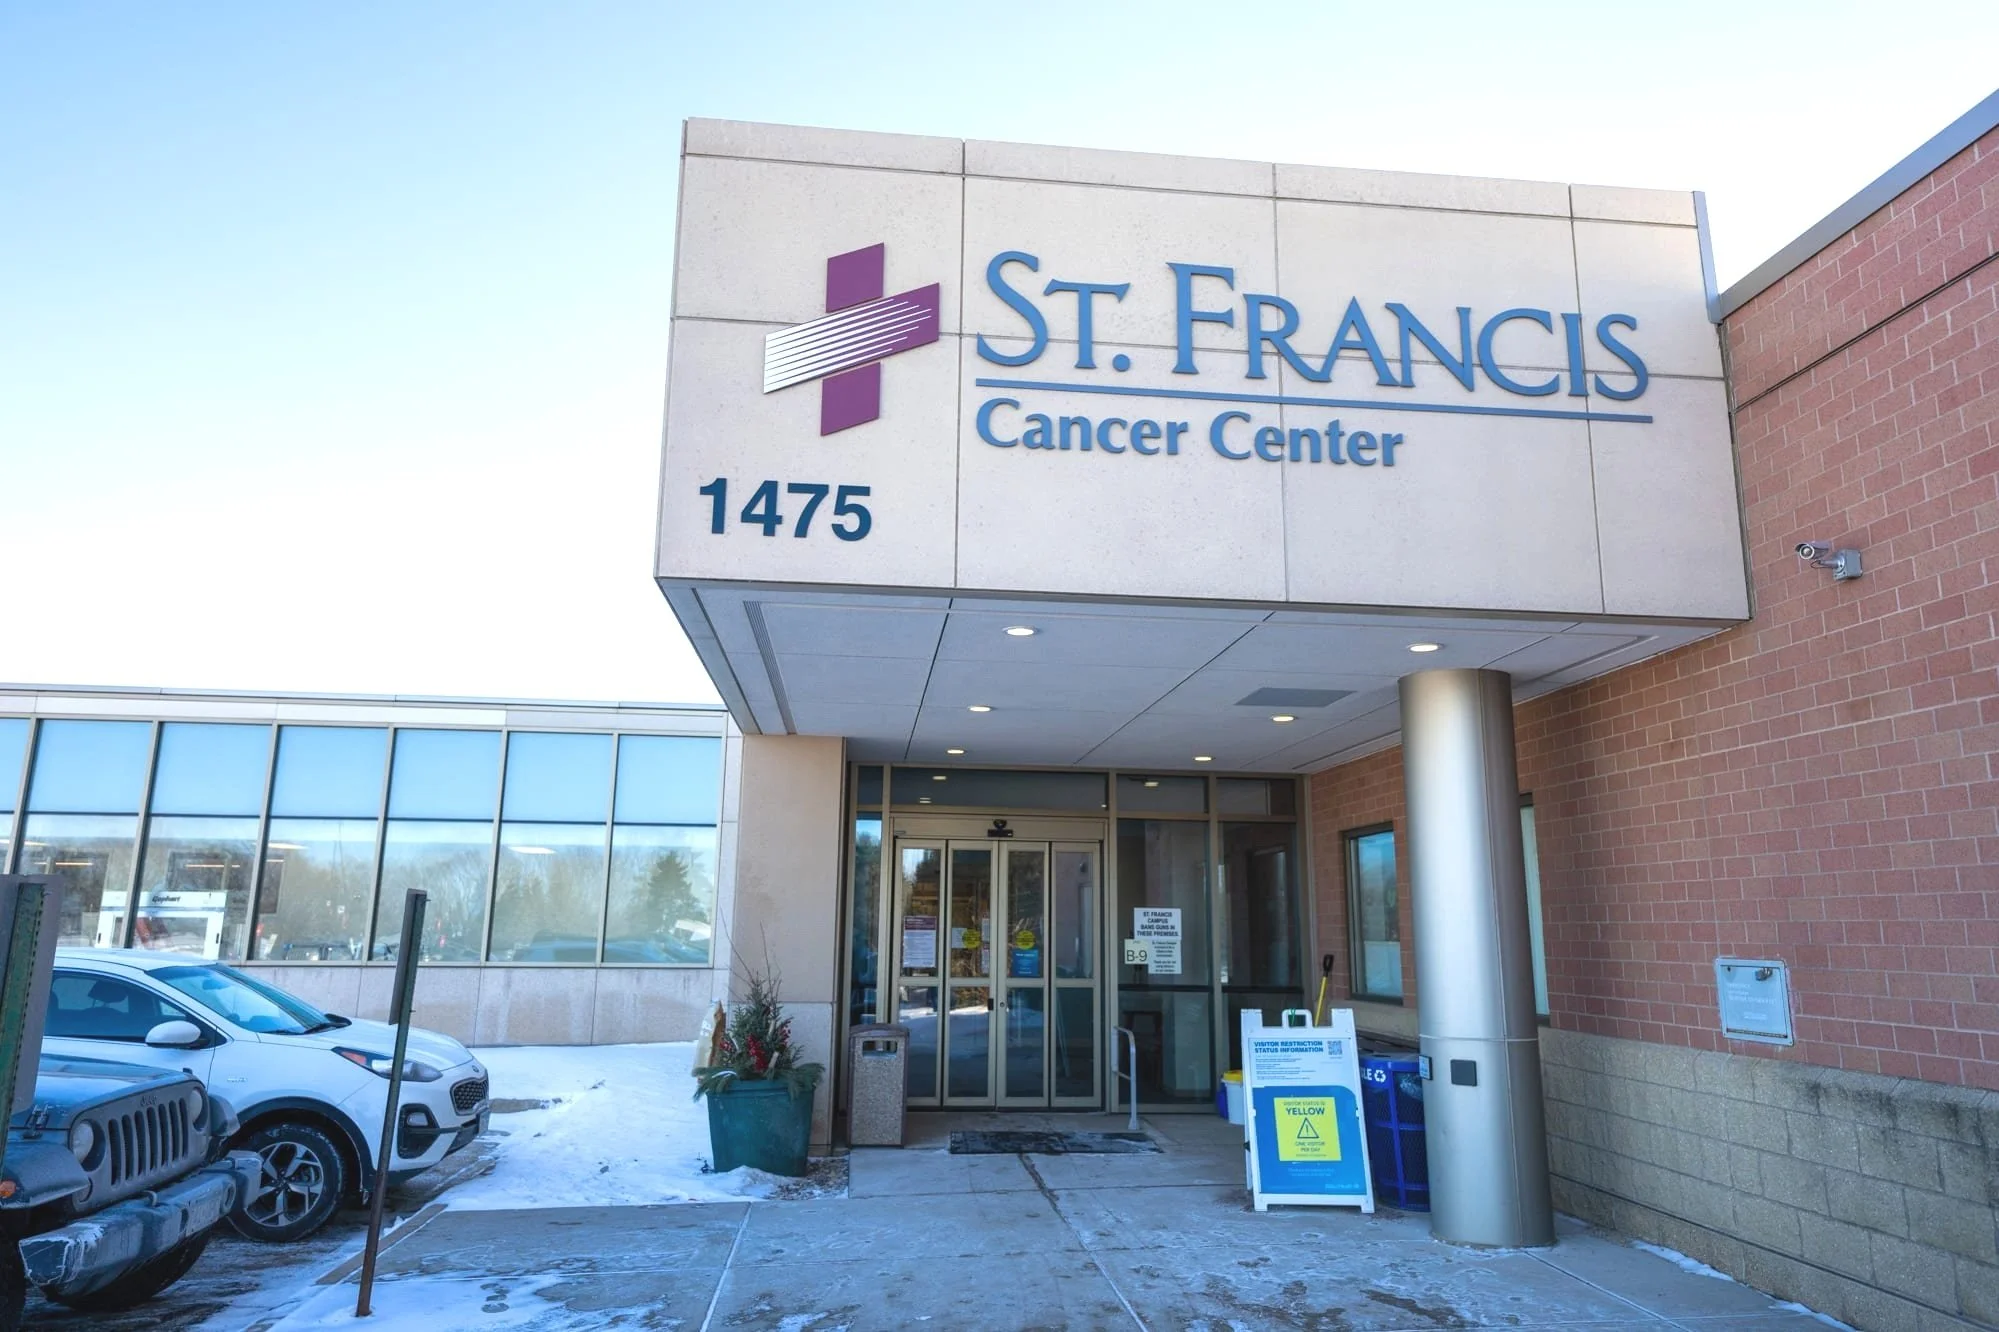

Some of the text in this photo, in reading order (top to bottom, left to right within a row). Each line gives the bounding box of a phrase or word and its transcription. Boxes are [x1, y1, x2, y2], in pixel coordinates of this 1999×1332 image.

[977, 250, 1649, 401] ST. FRANCIS
[976, 397, 1404, 467] Cancer Center
[700, 477, 872, 541] 1475
[1126, 949, 1148, 962] B-9
[1285, 1107, 1325, 1116] YELLOW
